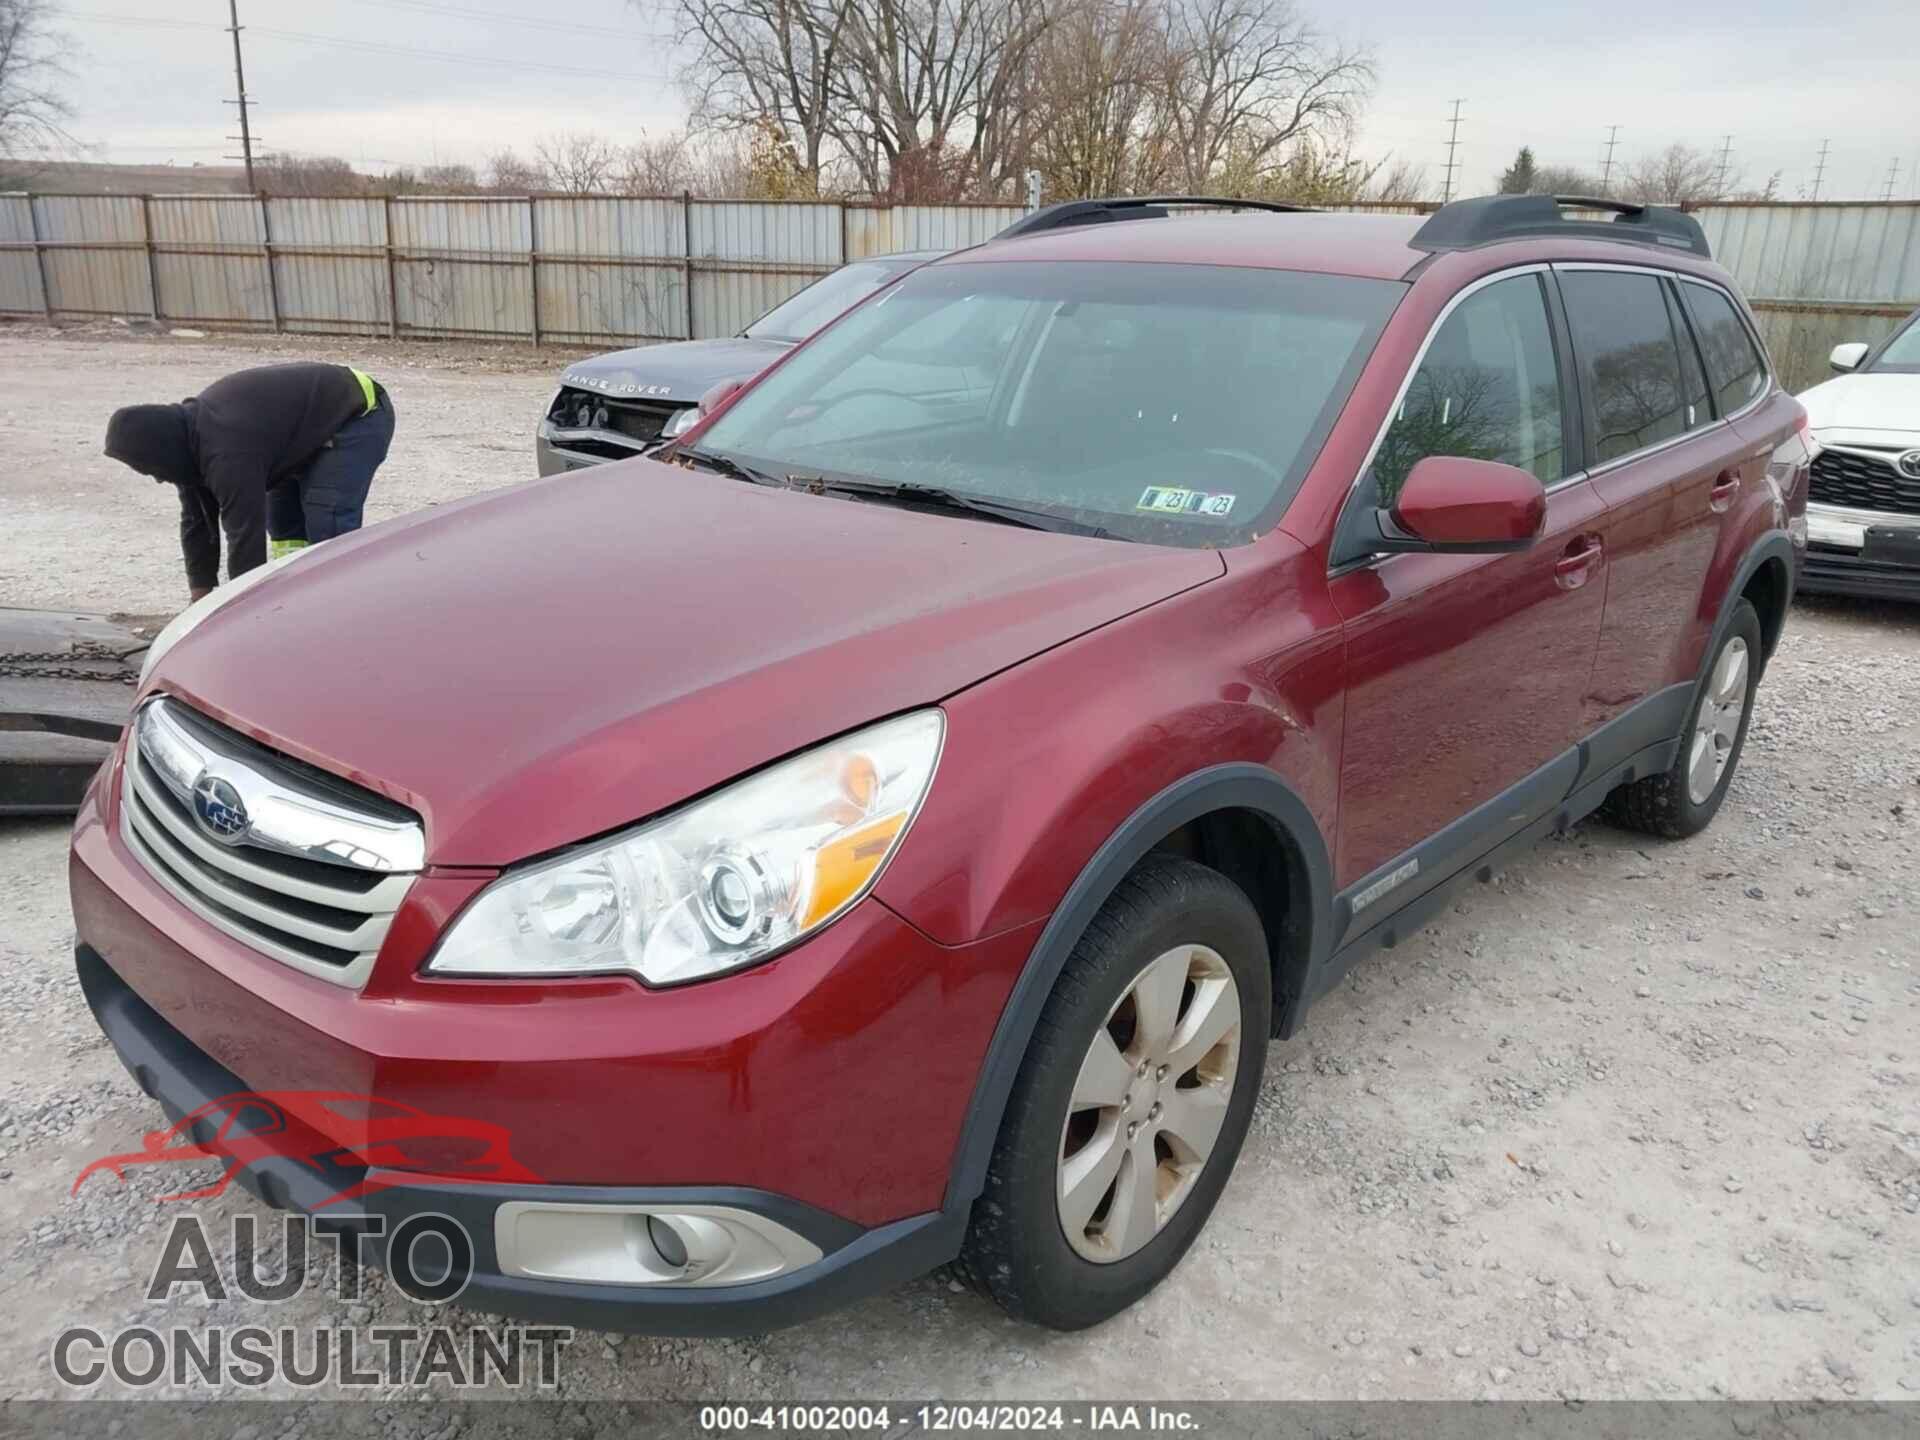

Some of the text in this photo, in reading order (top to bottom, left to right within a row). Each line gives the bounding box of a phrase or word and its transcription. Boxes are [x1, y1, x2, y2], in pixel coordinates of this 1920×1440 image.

[565, 373, 672, 396] RANGE ROVER
[1166, 492, 1184, 508] 23
[1212, 496, 1229, 513] 23
